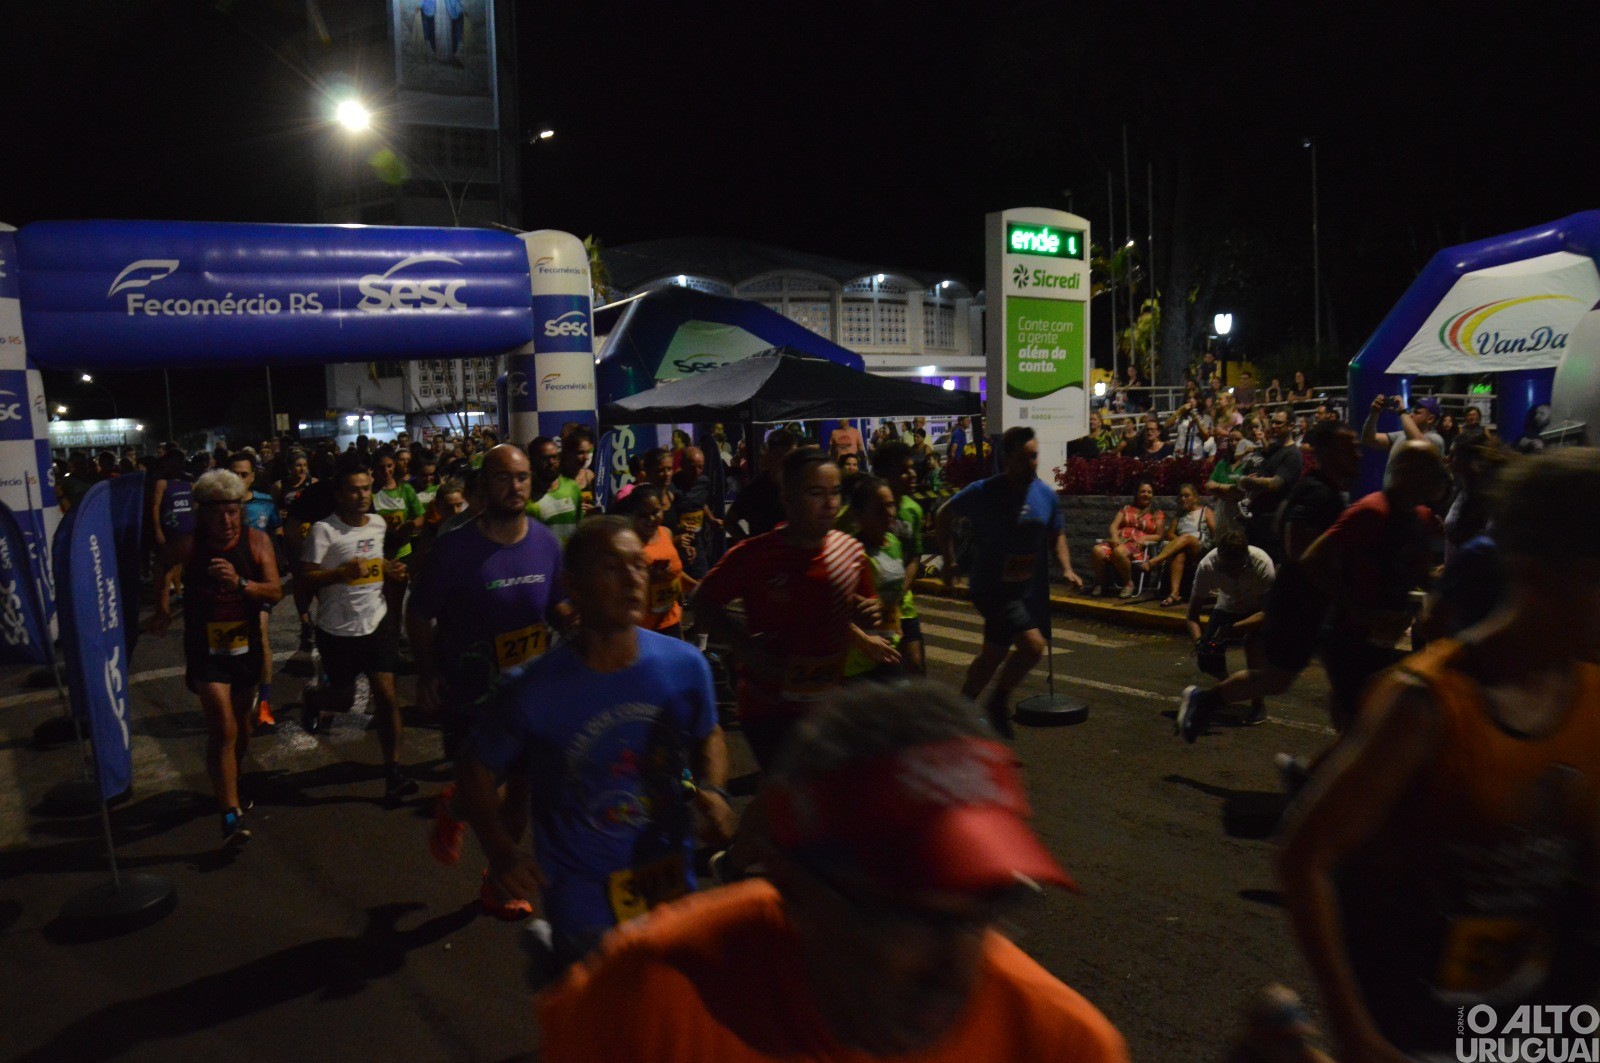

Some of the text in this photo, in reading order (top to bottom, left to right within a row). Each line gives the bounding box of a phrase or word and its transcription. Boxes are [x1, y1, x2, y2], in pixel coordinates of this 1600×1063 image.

[1032, 268, 1080, 289] Sicredi
[127, 292, 323, 316] Fecomércio RS
[1018, 316, 1074, 332] Conte com
[1018, 332, 1058, 345] a gente
[1018, 344, 1067, 360] além da
[1018, 361, 1057, 373] conta.
[502, 630, 542, 658] 277
